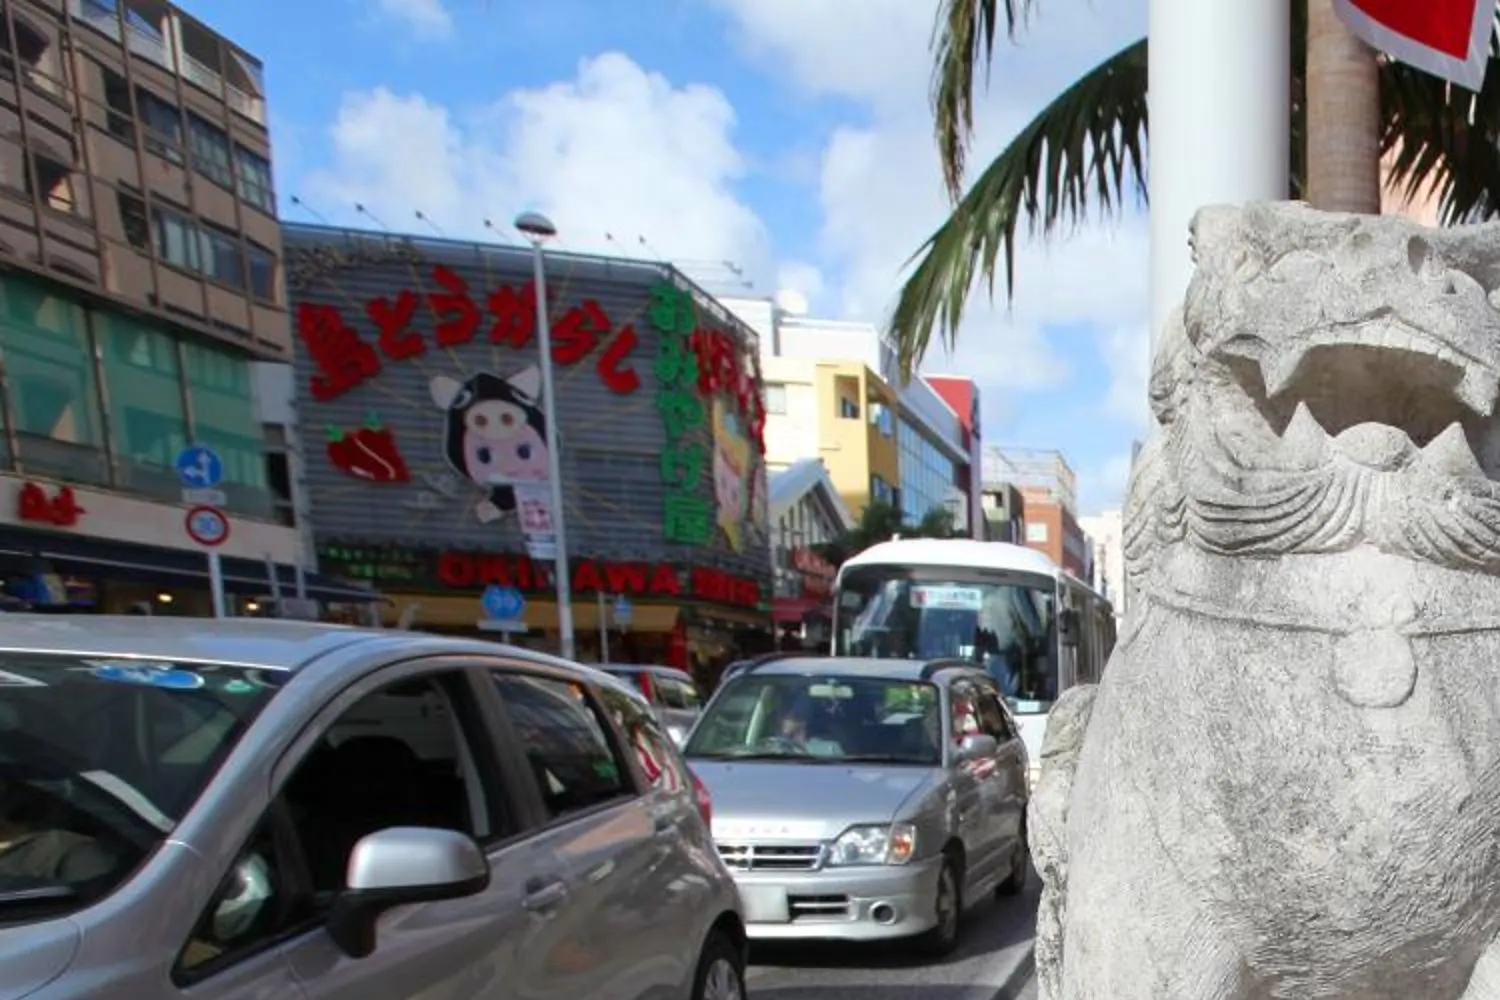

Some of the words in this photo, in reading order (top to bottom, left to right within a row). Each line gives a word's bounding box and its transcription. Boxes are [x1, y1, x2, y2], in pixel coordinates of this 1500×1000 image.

[297, 263, 643, 402] 島とうがらし
